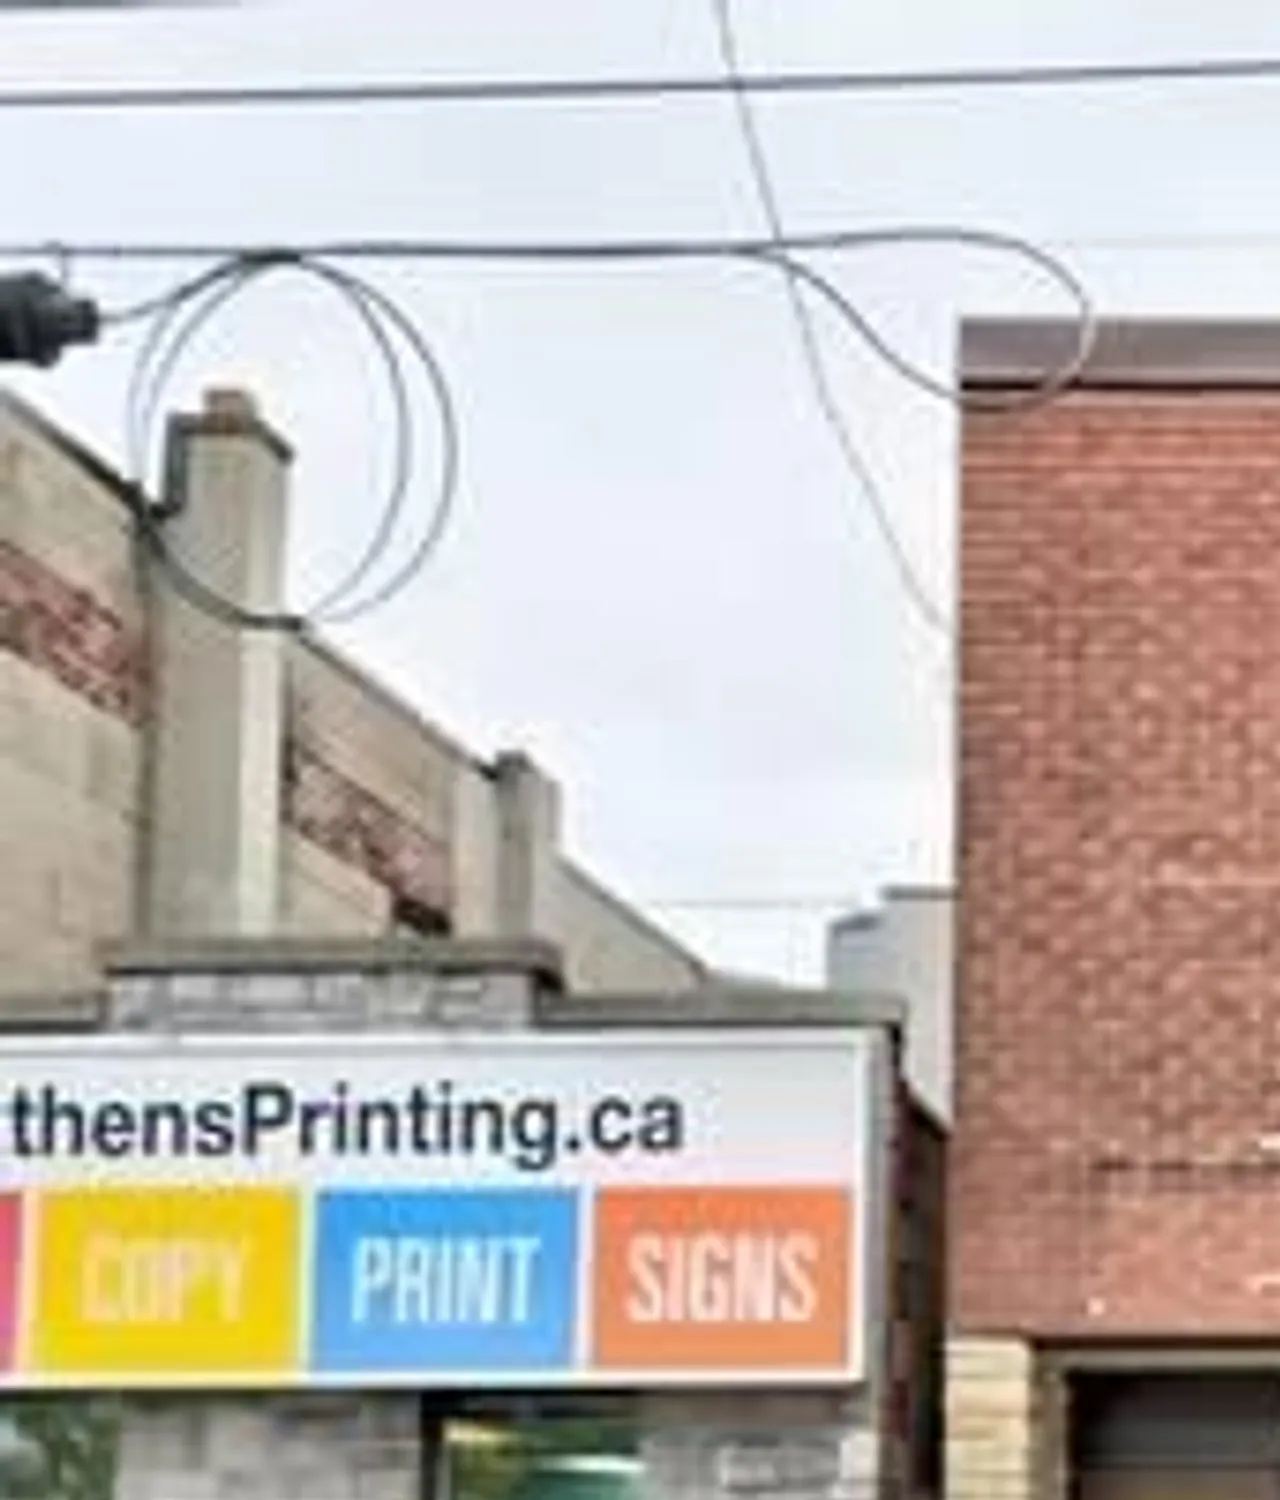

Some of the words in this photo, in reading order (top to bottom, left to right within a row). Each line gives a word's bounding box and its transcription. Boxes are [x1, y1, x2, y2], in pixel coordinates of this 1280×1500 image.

[8, 1081, 686, 1170] thensPrinting.ca
[82, 1236, 251, 1323] COPY
[351, 1236, 541, 1323] PRINT
[626, 1233, 818, 1323] SIGNS
